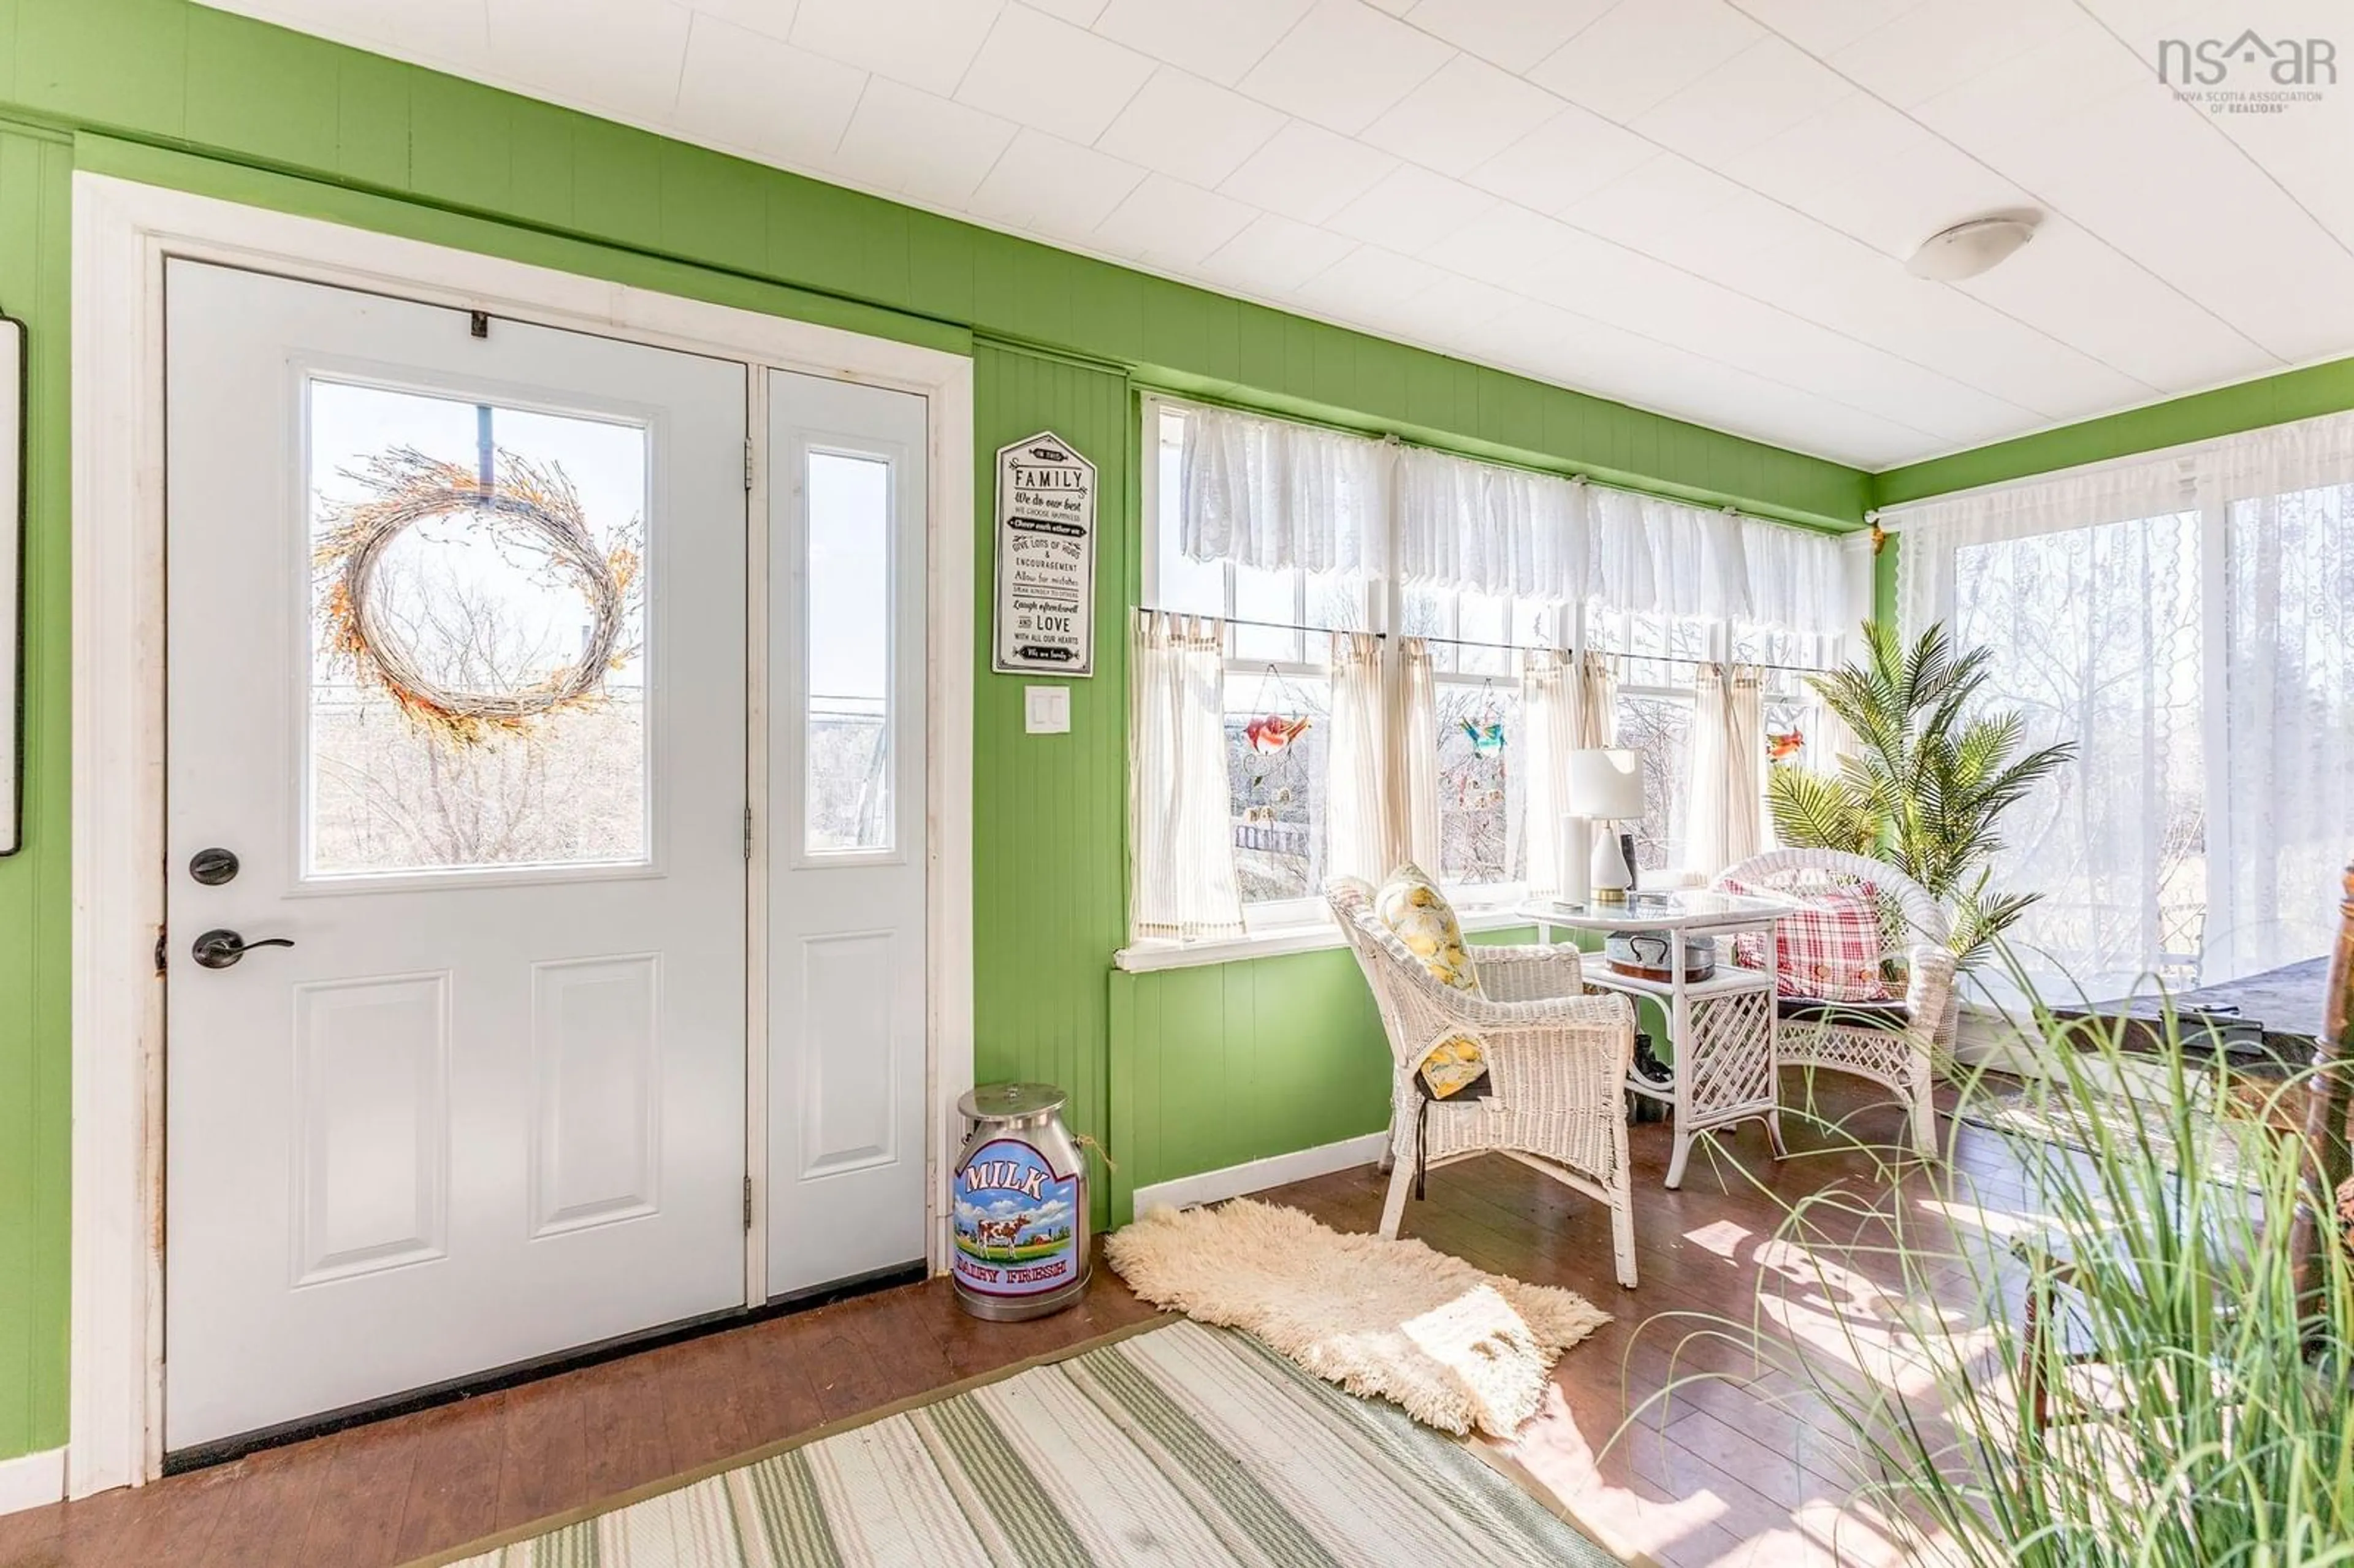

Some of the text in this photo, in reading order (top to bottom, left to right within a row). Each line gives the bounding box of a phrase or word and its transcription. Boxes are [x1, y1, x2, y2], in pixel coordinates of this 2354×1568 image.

[1015, 470, 1082, 487] FAMILY
[1015, 492, 1081, 511] We do our best
[1012, 540, 1029, 552] GIVE
[1031, 539, 1048, 548] LOTS
[1016, 557, 1077, 571] ENCOURAGEMENT
[1015, 571, 1036, 581] Allow
[1038, 573, 1048, 583] for
[1013, 599, 1038, 612] Laugh
[1038, 602, 1057, 613] often
[1037, 615, 1070, 632] LOVE
[966, 1160, 1049, 1201] MILK
[956, 1254, 1067, 1284] DAIRY FRESH
